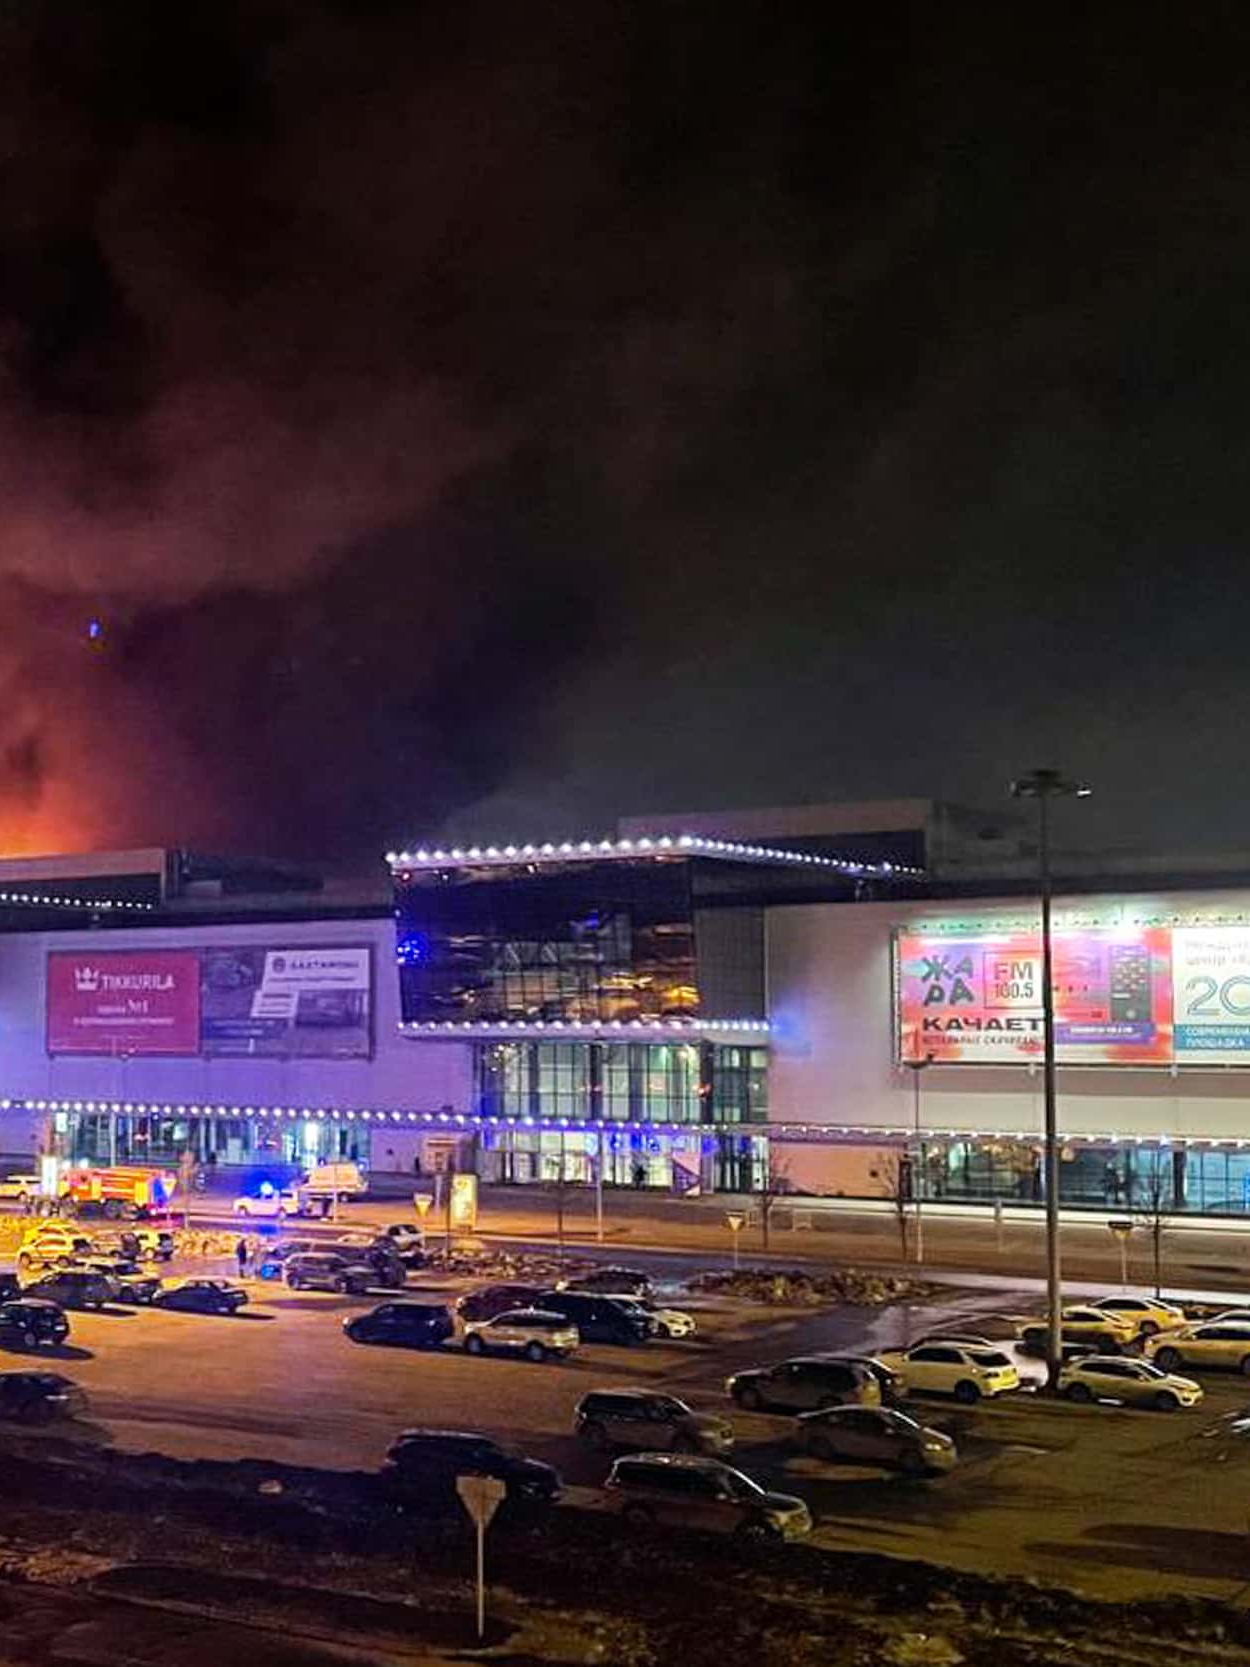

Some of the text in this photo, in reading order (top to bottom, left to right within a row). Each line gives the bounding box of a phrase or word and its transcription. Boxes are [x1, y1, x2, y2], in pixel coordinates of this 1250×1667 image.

[994, 961, 1033, 981] FM
[101, 974, 175, 991] TIKKURILA
[994, 982, 1034, 999] 100.5
[922, 1018, 1044, 1031] КАЧАЕТ
